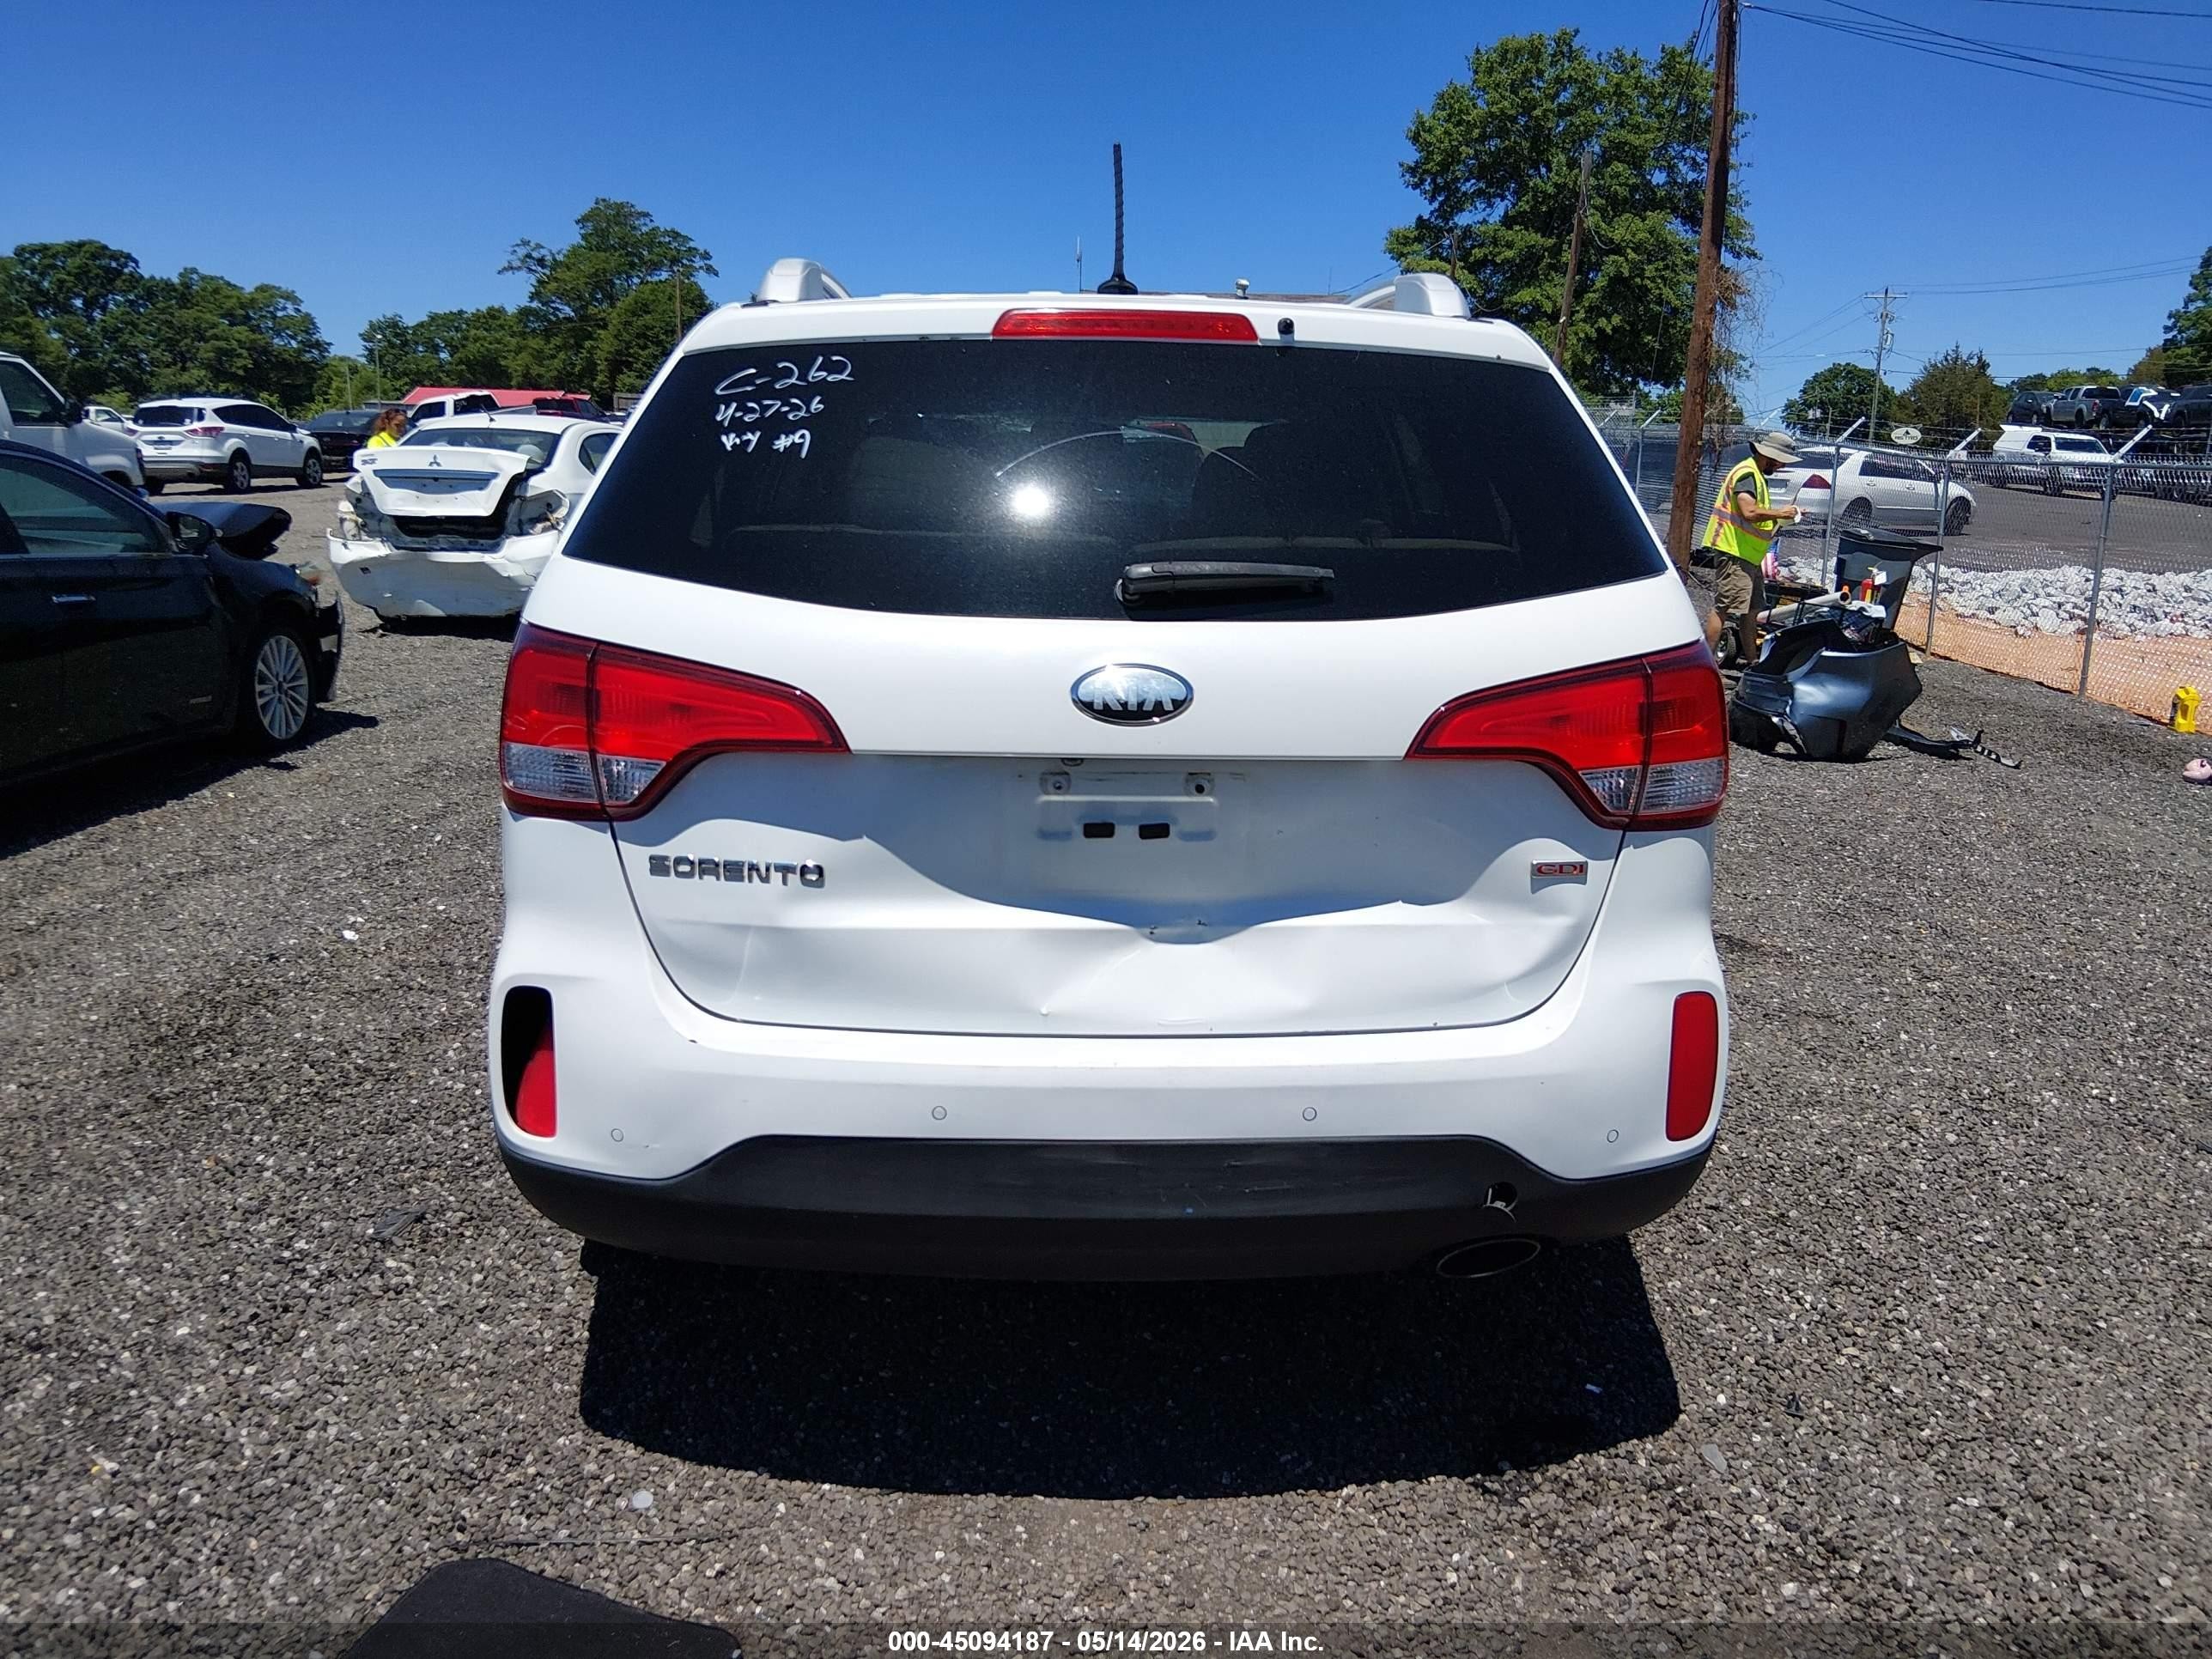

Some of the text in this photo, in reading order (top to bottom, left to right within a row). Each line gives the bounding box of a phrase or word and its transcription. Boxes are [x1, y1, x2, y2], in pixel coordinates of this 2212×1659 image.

[715, 356, 855, 396] C-262
[715, 395, 824, 428] 4-27-26
[771, 428, 811, 459] #9
[1092, 677, 1175, 711] KIA
[648, 854, 826, 889] SORENTO
[1536, 864, 1584, 875] GDI
